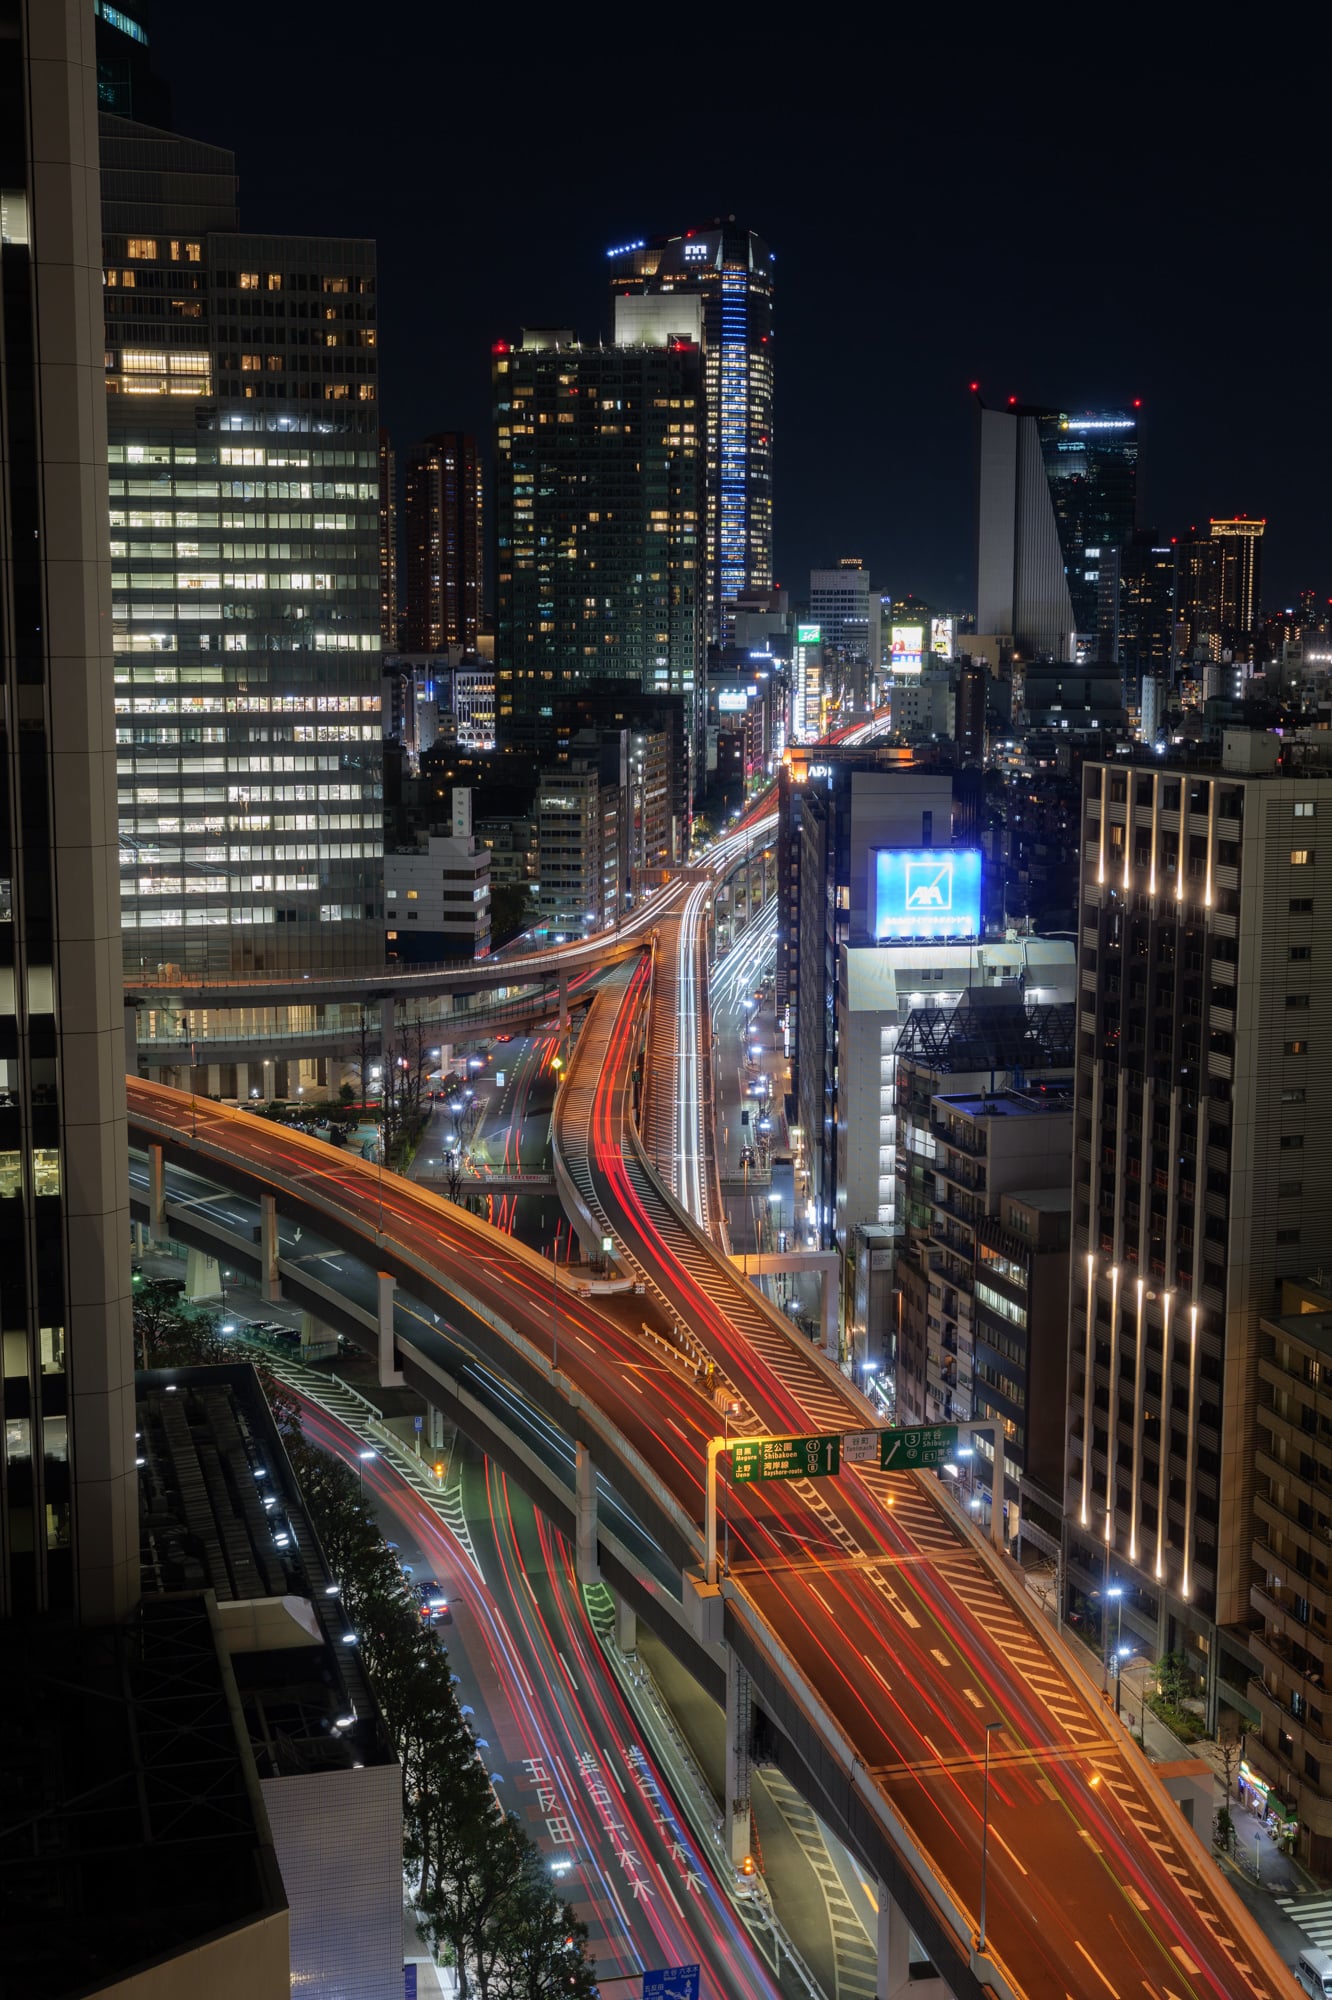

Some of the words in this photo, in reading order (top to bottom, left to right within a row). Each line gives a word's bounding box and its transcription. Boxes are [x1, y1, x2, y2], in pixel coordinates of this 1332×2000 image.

[923, 1431, 942, 1440] 渋谷
[764, 1442, 793, 1453] 芝公園
[922, 1439, 951, 1448] Shibuya
[736, 1447, 752, 1456] 目黒
[764, 1452, 798, 1460] Shibakoen
[736, 1464, 751, 1473] 上野
[764, 1461, 789, 1470] 湾岸線
[522, 1757, 576, 1844] 五反田
